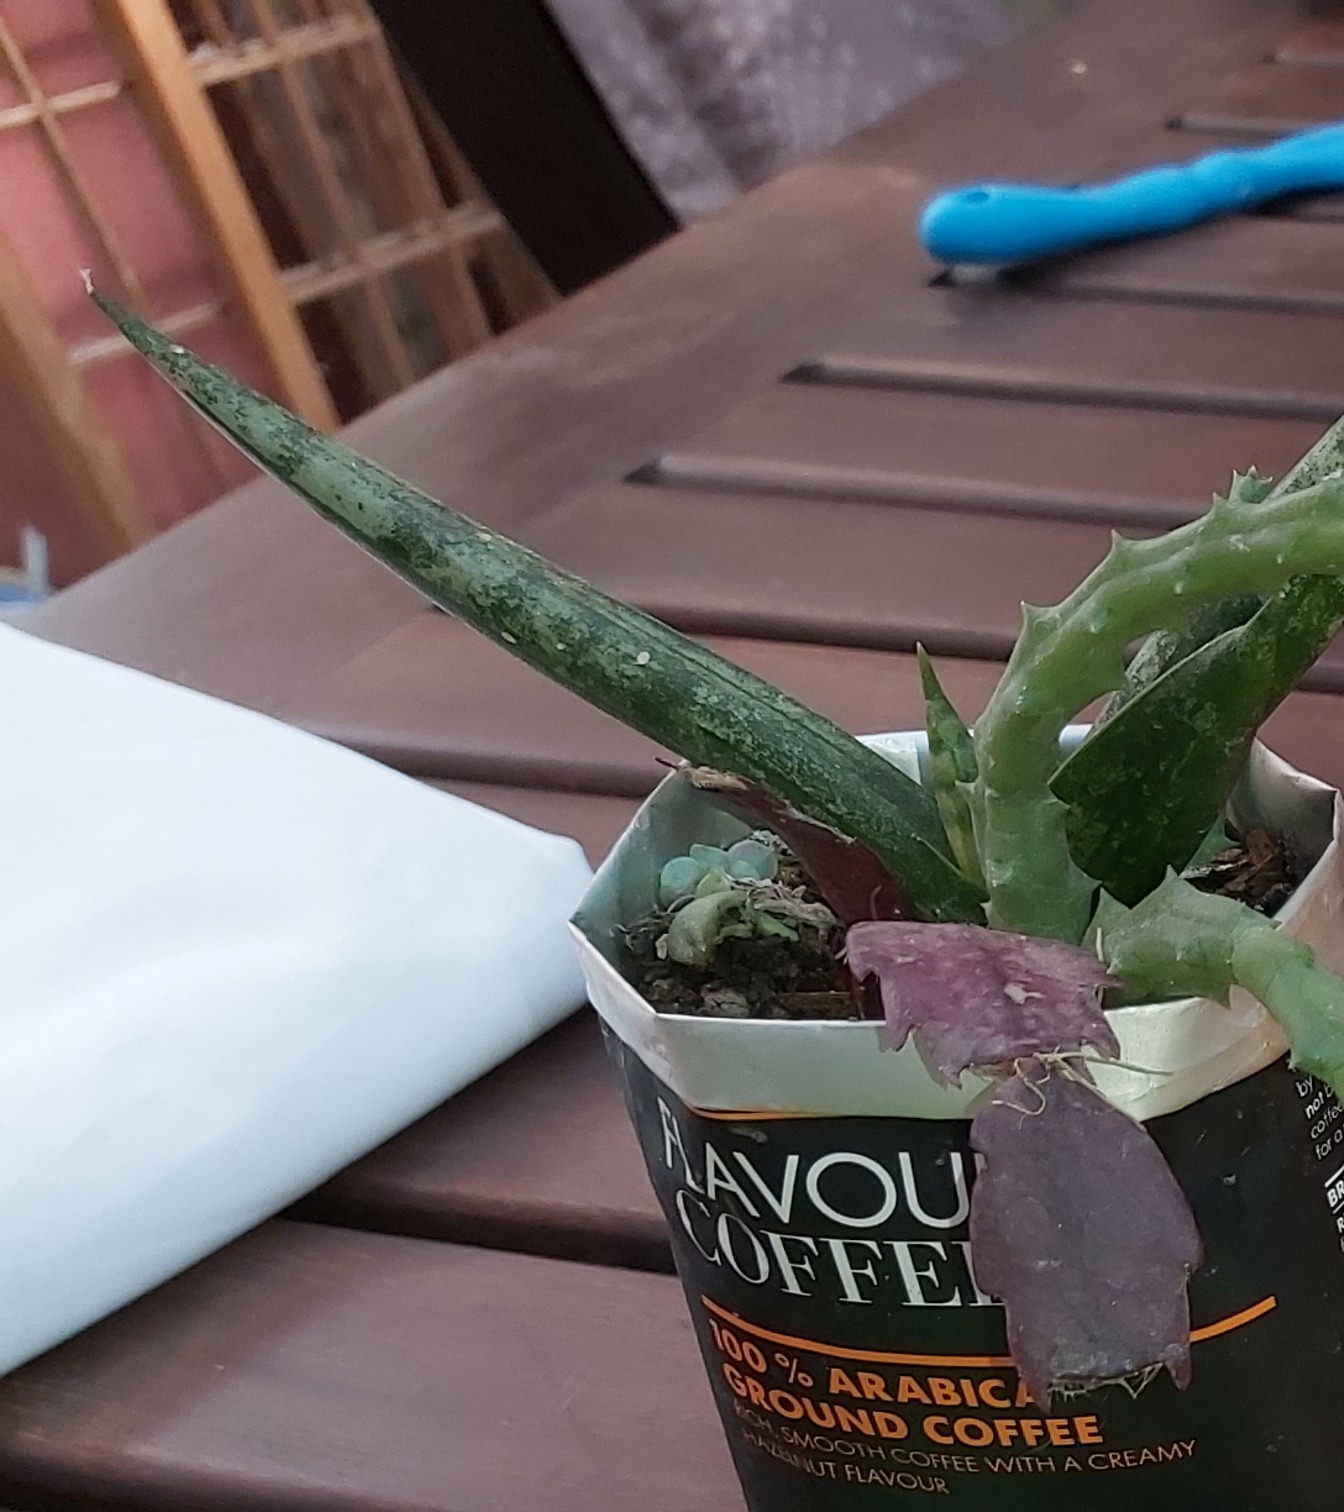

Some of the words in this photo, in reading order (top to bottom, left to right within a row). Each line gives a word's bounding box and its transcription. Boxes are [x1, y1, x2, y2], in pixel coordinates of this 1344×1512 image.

[656, 1095, 986, 1229] FLAVOU
[708, 1317, 768, 1374] 100
[774, 1352, 815, 1388] %
[722, 1362, 909, 1440] GROUND
[923, 1414, 1104, 1447] COFFEE
[780, 1424, 886, 1461] SMOOTH
[890, 1447, 981, 1473] COFFEE
[983, 1455, 1056, 1473] WITH
[1063, 1455, 1084, 1472] A
[1087, 1439, 1197, 1470] CREAMY
[843, 1463, 950, 1495] FLAVOUR
